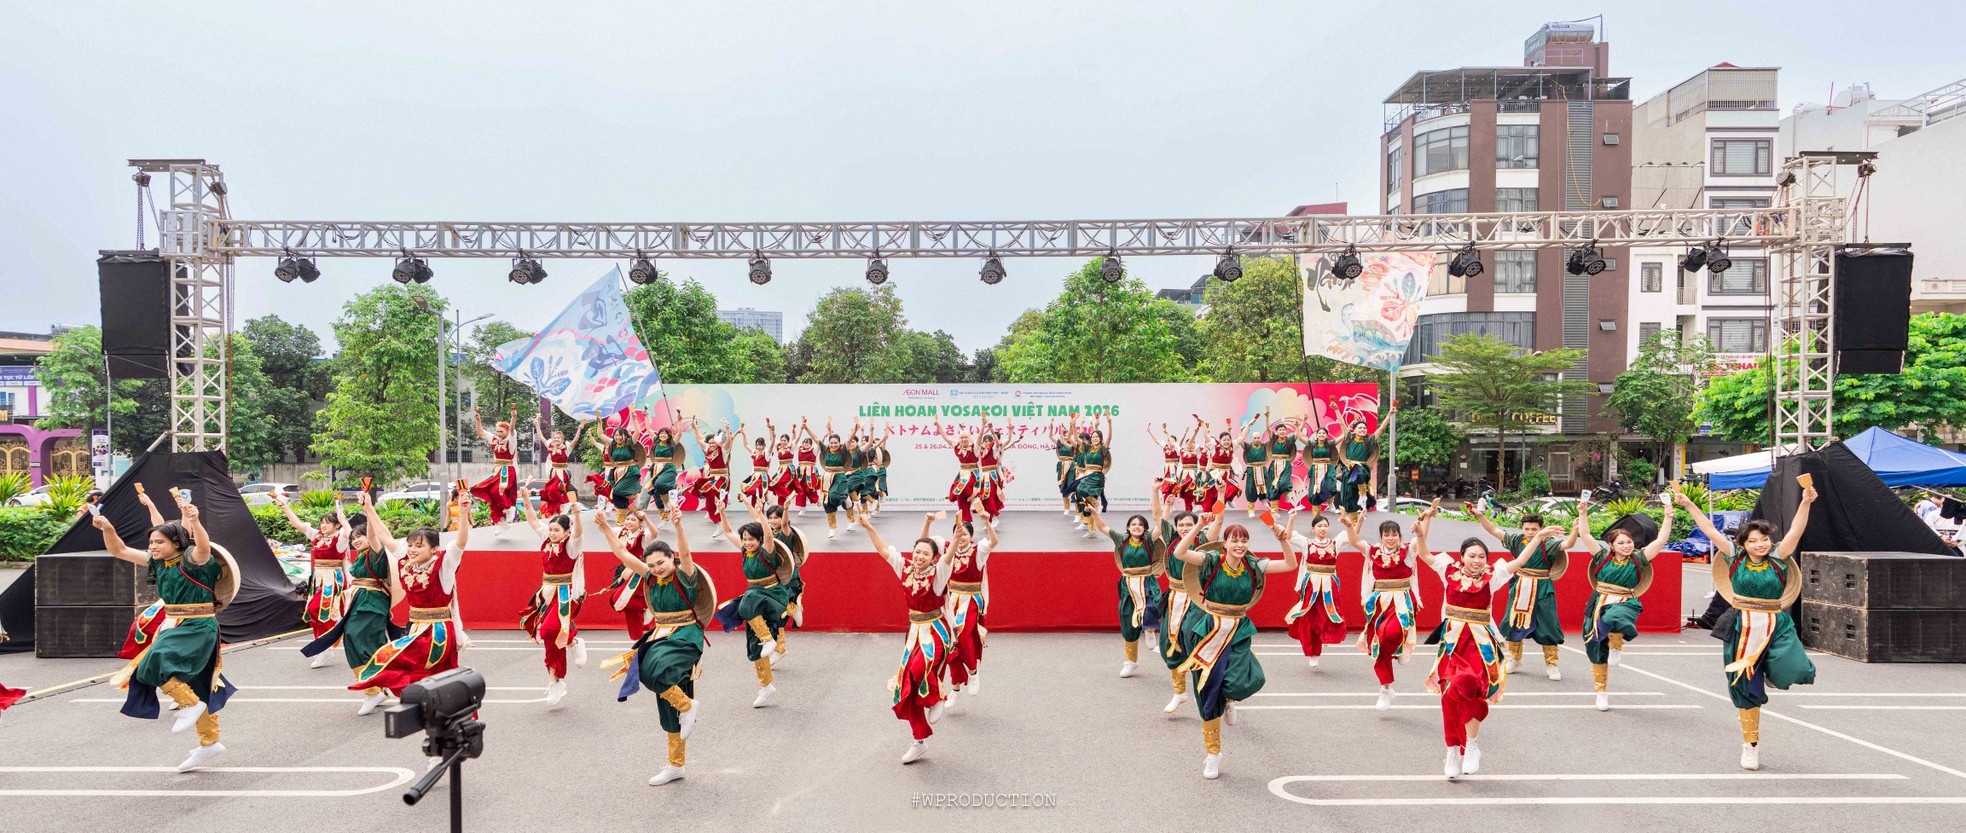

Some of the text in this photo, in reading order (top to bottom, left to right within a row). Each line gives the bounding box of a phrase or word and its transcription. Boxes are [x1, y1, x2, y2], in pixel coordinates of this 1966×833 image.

[859, 401, 890, 417] LIÊN
[895, 405, 937, 416] HOAN
[941, 404, 1007, 417] YOSAKOI
[1012, 401, 1043, 420] VIỆT
[1048, 405, 1080, 416] NAM
[1511, 411, 1556, 424] COFFEE
